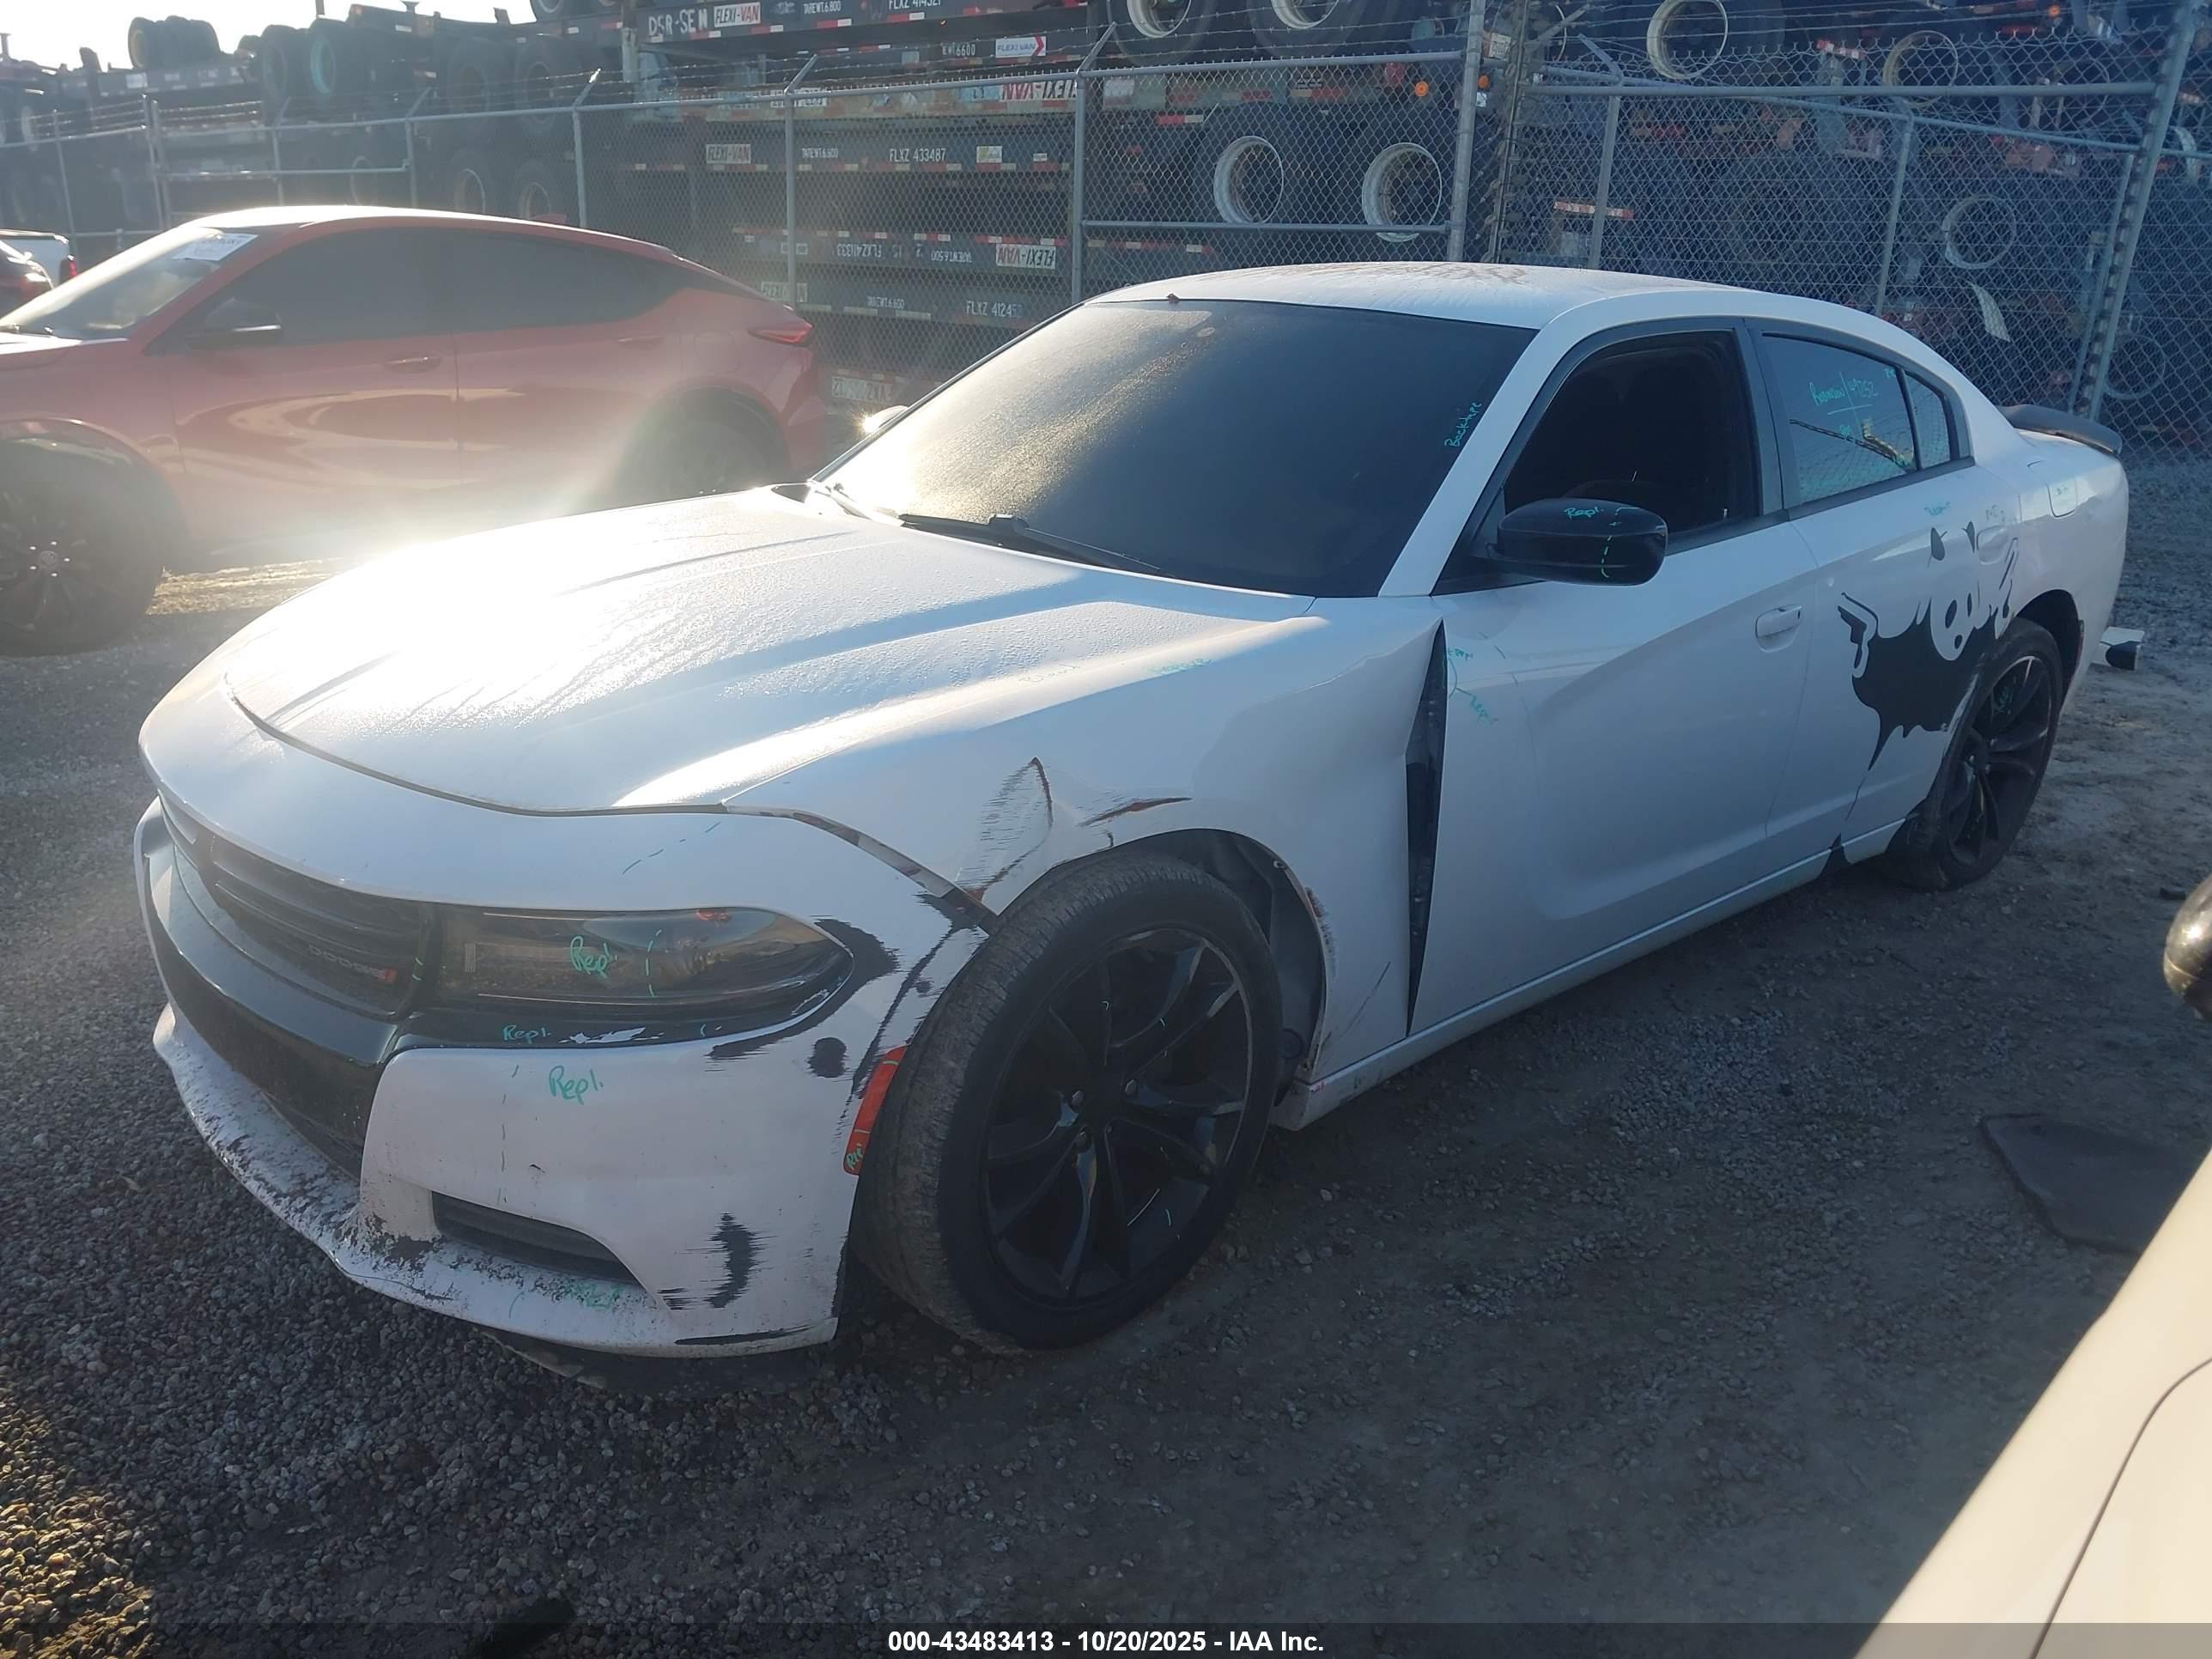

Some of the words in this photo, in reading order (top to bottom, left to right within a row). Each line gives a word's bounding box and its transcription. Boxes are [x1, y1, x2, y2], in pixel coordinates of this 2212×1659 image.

[716, 5, 760, 25] FLEXI-VAN
[889, 148, 910, 162] FLXZ
[913, 147, 946, 162] 433487
[998, 246, 1055, 267] FLEXI-VAN
[966, 301, 988, 316] FLXZ
